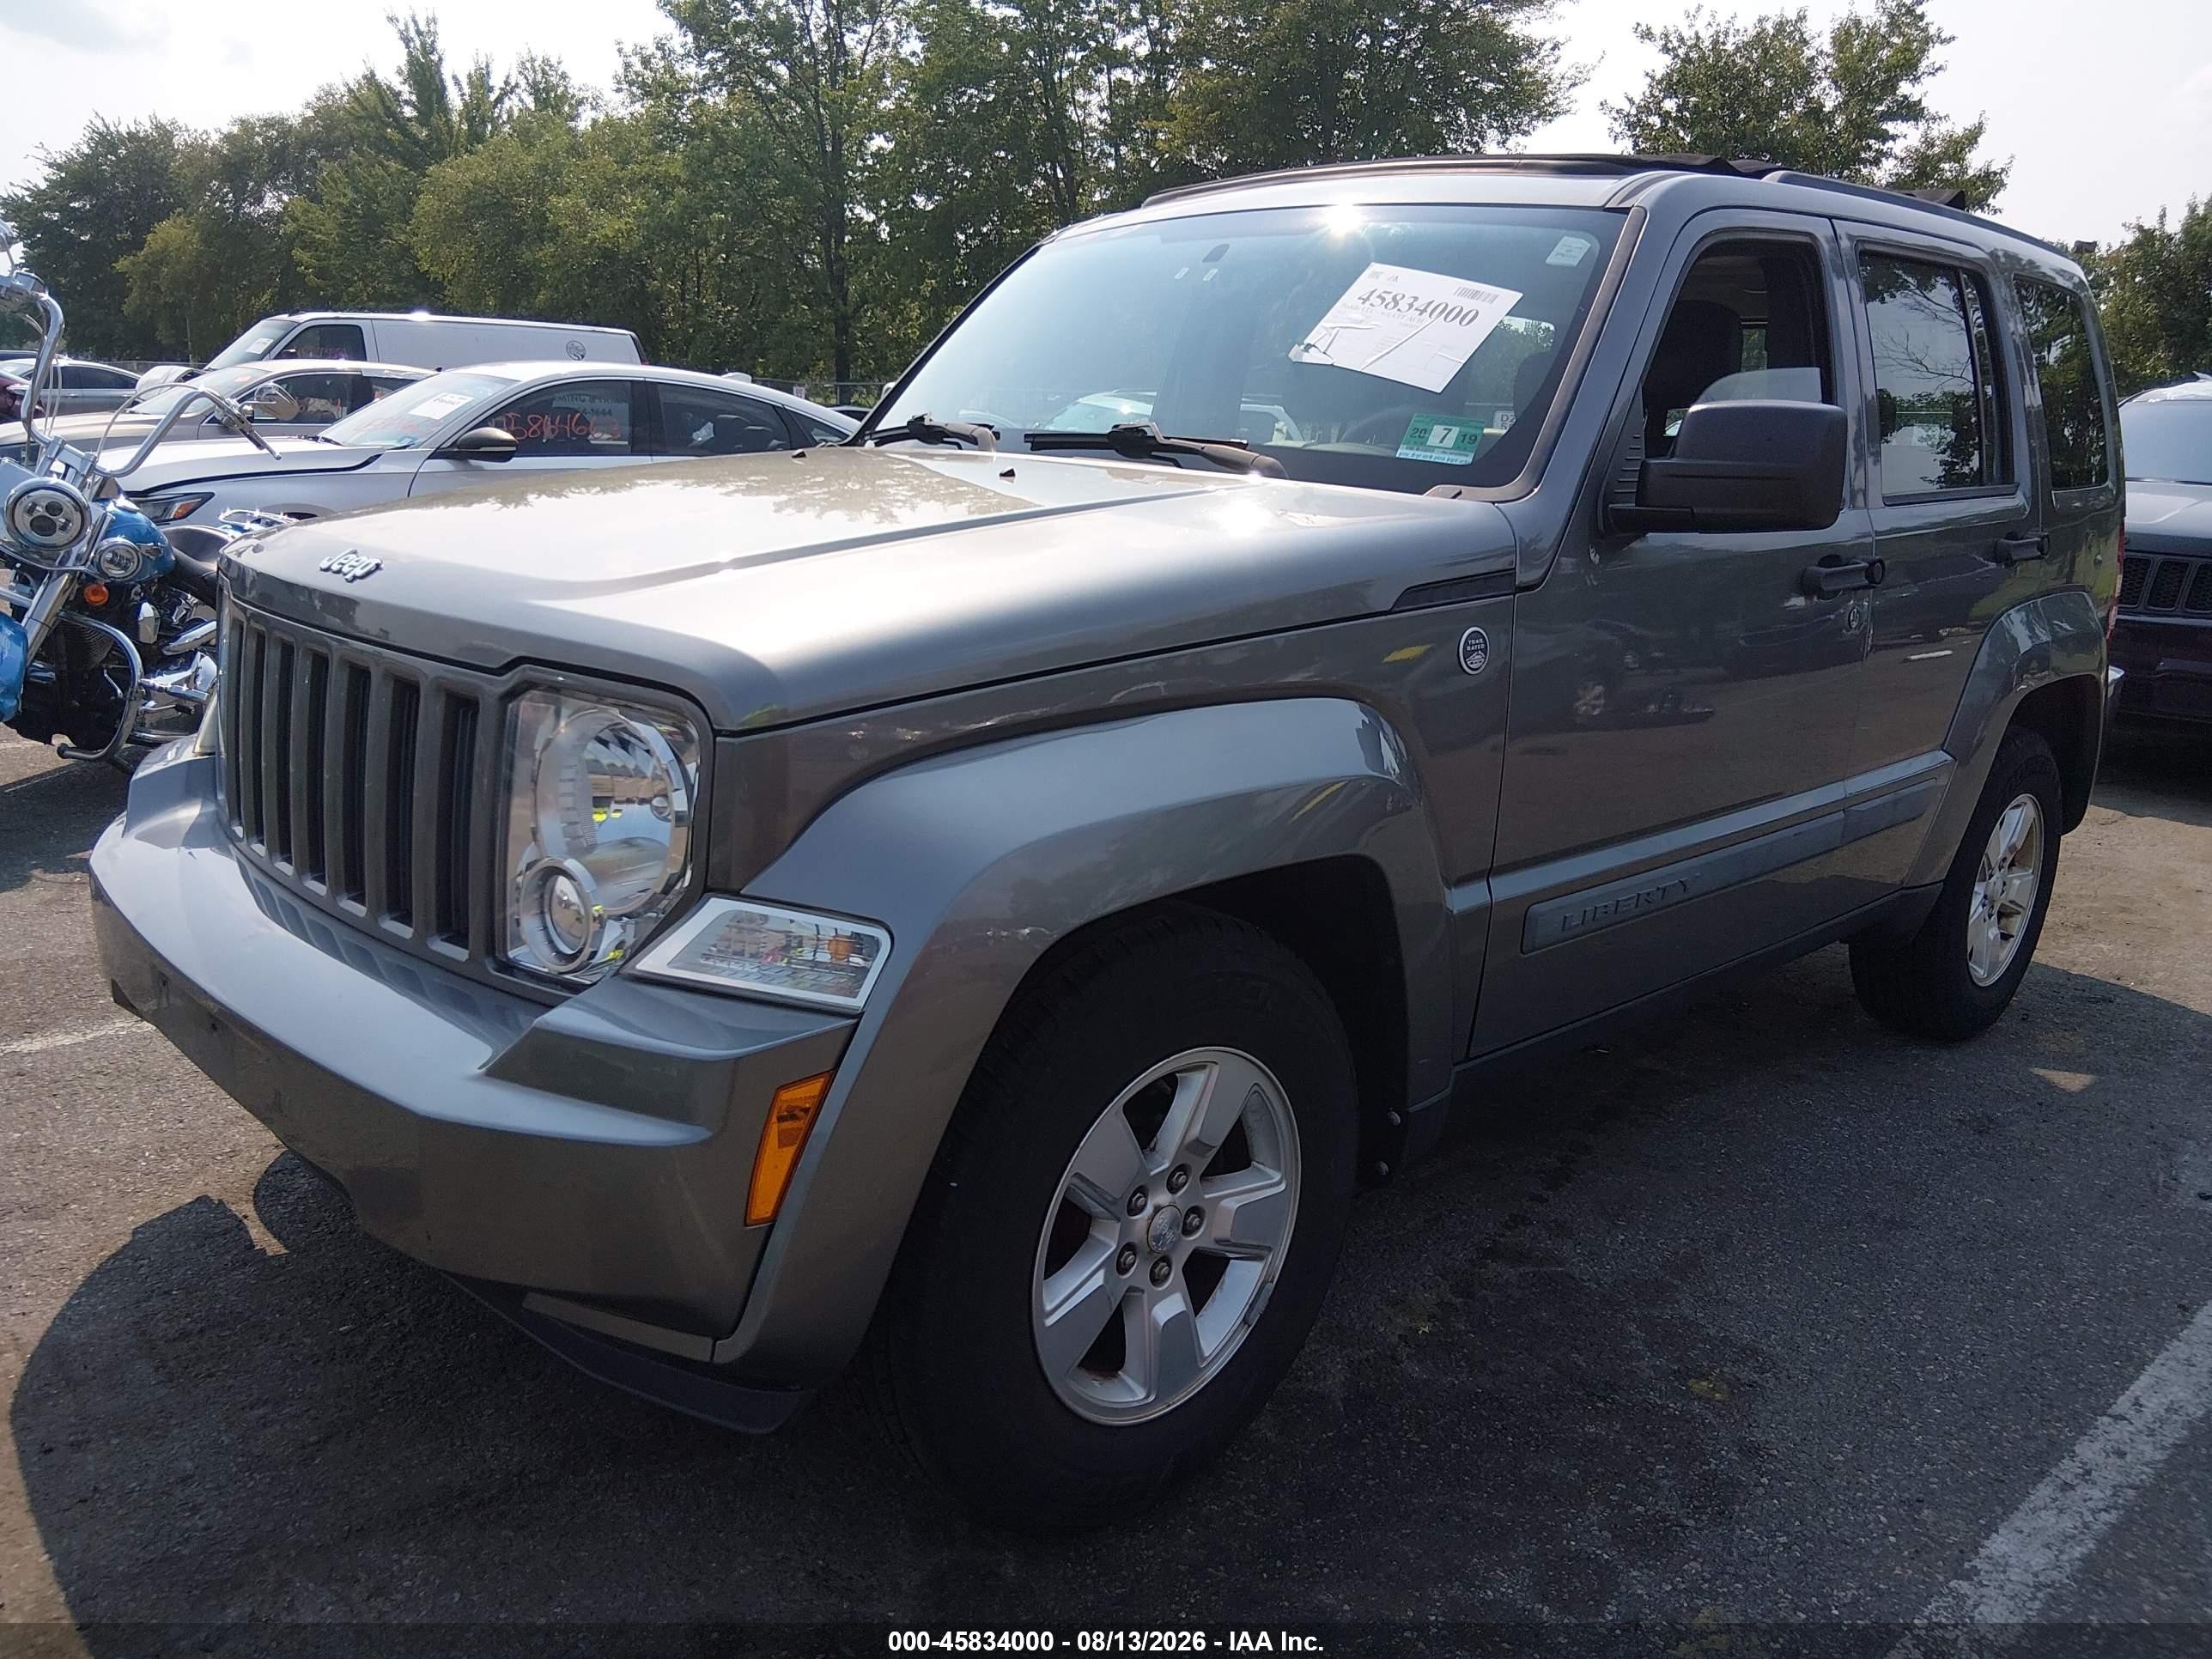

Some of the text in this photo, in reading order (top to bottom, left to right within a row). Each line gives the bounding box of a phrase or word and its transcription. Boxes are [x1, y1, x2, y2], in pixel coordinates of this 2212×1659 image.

[1357, 288, 1480, 327] 45834000
[1438, 428, 1453, 444] 7
[1461, 433, 1478, 445] 19
[319, 548, 381, 583] Jeep
[1559, 878, 1690, 933] LIBERTY
